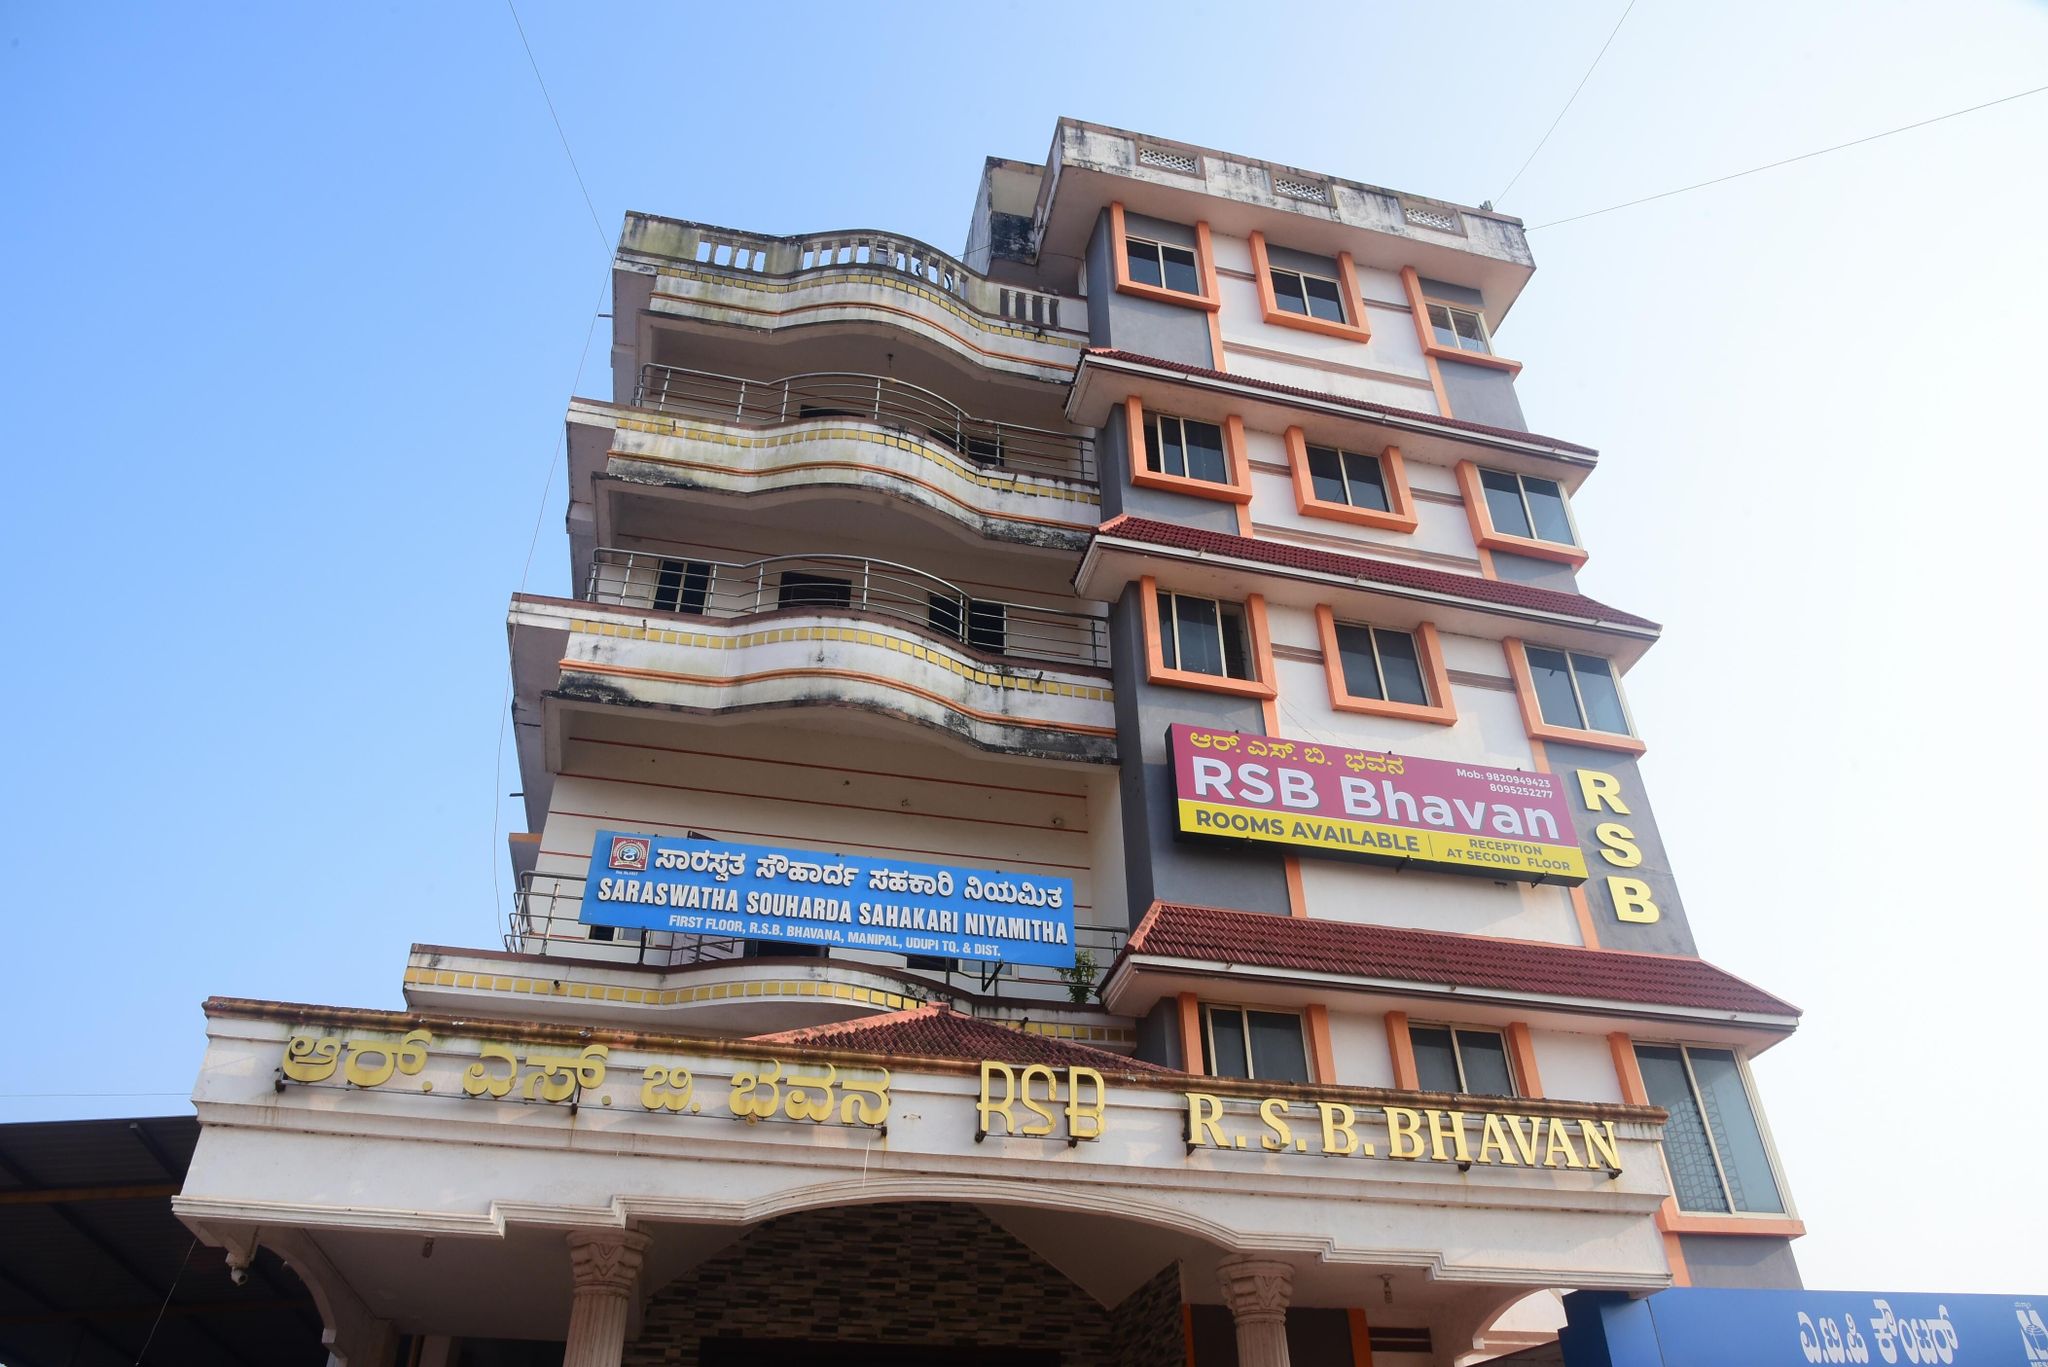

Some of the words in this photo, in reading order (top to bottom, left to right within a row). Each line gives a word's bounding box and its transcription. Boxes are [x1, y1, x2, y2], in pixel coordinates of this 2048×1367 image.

[1344, 752, 1405, 776] ಭವನ
[1456, 768, 1485, 780] Mob:
[1486, 772, 1551, 788] 9820949423
[1192, 756, 1320, 809] RSB
[1340, 776, 1560, 840] Bhavan
[1490, 783, 1553, 799] 8095252277
[1195, 809, 1285, 836] ROOMS
[1291, 821, 1420, 852] AVAILABLE
[1469, 838, 1543, 856] RECEPTION
[655, 848, 746, 882] ಸಾರಸ್ವತ
[755, 854, 860, 887] ಸೌಹಾರ್ದ
[869, 868, 954, 897] ಸಹಕಾರಿ
[964, 876, 1064, 909] ನಿಯಮಿತ
[1447, 848, 1466, 859] AT
[1467, 850, 1521, 866] SECOND
[1528, 857, 1571, 871] FLOOR
[598, 877, 738, 912] SARASWATHA
[746, 891, 852, 923] SOUHARDA
[859, 902, 958, 934] SAHAKARI
[965, 913, 1068, 944] NIYAMITHA
[669, 914, 703, 929] FIRST
[705, 917, 746, 934] FLOOR,
[750, 923, 783, 936] R.S.B.
[787, 926, 844, 943] BHAVANA,
[848, 931, 903, 949] MANIPAL,
[906, 937, 939, 951] UDUPI
[942, 940, 960, 953] TQ.
[963, 942, 971, 954] &
[975, 944, 1001, 956] DIST.
[728, 1057, 891, 1126] ಭವನ
[976, 1060, 1106, 1140] RSB
